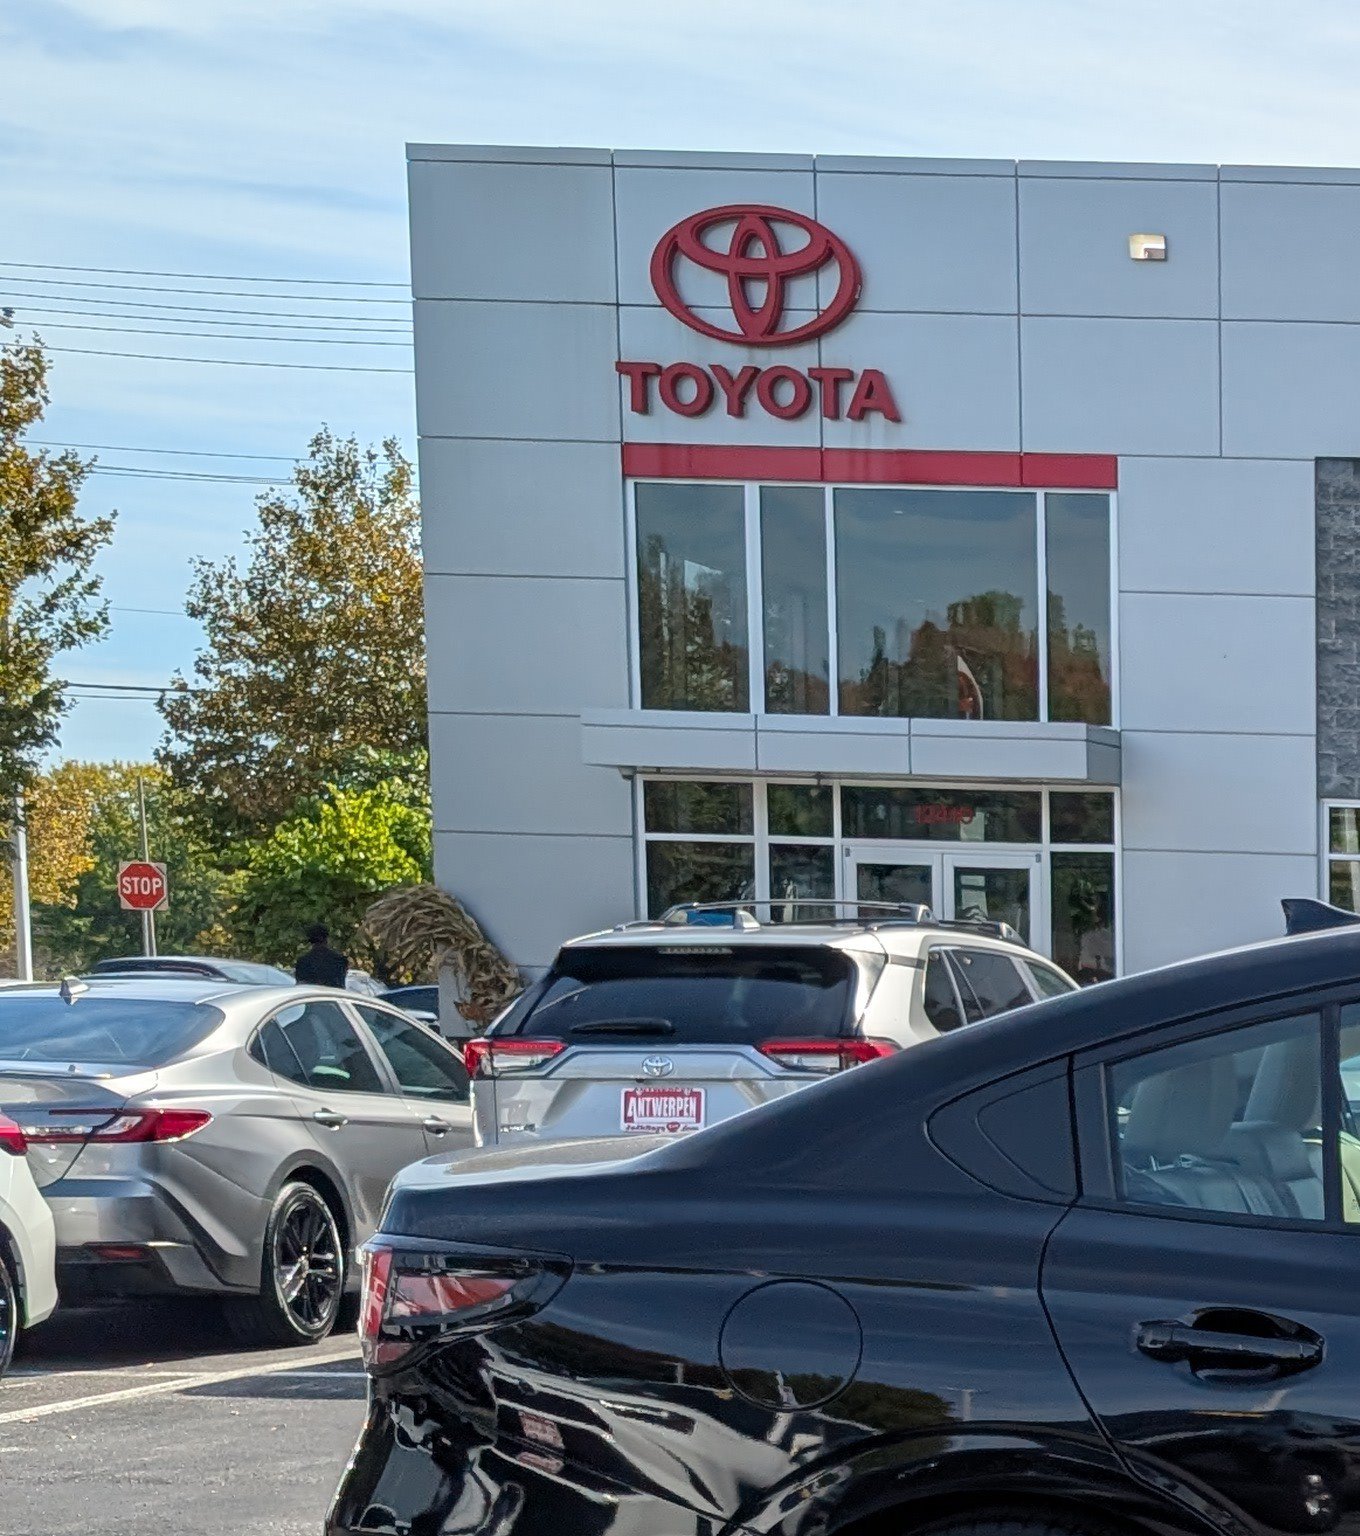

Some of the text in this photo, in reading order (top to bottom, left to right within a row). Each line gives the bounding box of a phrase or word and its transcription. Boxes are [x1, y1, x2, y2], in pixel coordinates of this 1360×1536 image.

[615, 361, 901, 422] TOYOTA
[122, 876, 162, 895] STOP
[626, 1096, 697, 1118] ANTWERPEN
